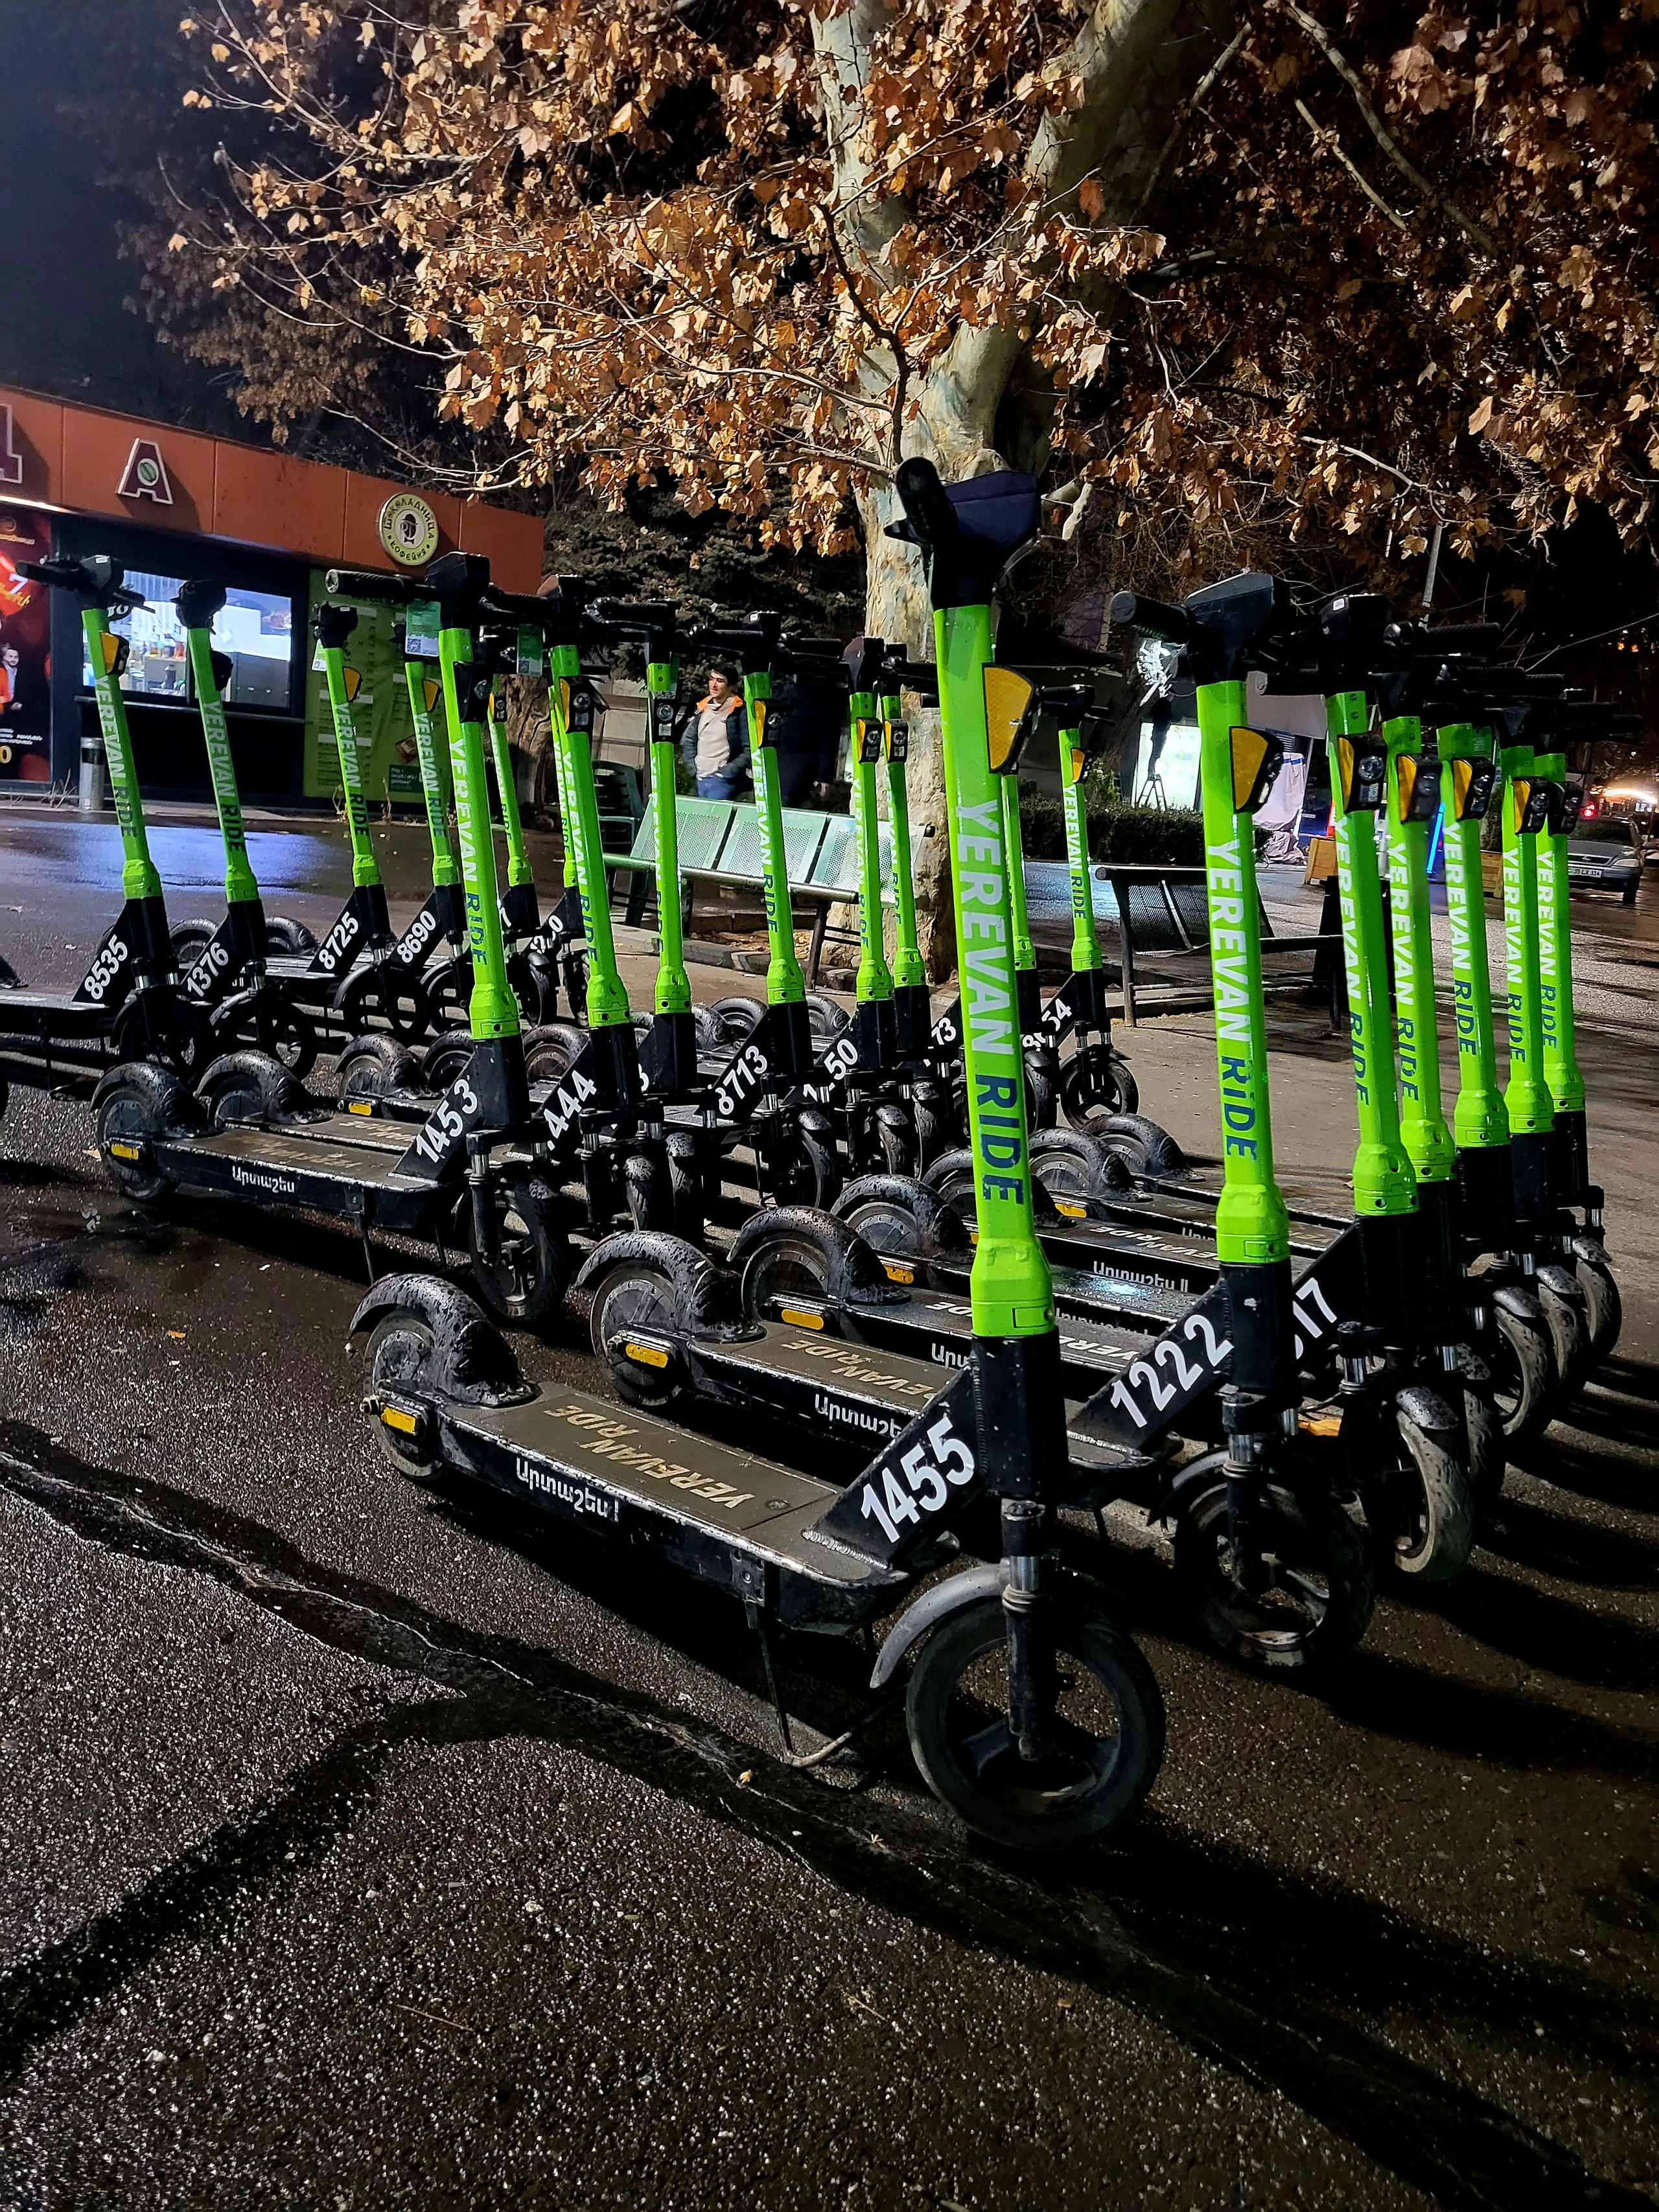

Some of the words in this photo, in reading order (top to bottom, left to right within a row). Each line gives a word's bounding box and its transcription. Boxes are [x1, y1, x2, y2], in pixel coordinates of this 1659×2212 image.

[390, 541, 426, 561] КОФЕЙНЯ
[96, 675, 126, 778] YEREVAN
[114, 786, 137, 837] RIDE
[203, 701, 235, 797] YEREVAN
[220, 803, 244, 852] RIDE
[335, 703, 361, 787] YEREVAN
[349, 793, 369, 836] RIDE
[415, 712, 439, 792] YEREVAN
[449, 738, 478, 882] YEREVAN
[466, 892, 487, 966] RIDE
[563, 751, 587, 885] YEREVAN
[580, 895, 597, 962] RIDE
[751, 749, 772, 865] YEREVAN
[763, 873, 778, 933] RIDE
[1063, 784, 1082, 870] YEREVAN
[956, 799, 1014, 1055] YEREVAN
[1071, 876, 1086, 919] RIDE
[1389, 843, 1414, 1006] YEREVAN
[1443, 822, 1472, 970] YEREVAN
[1503, 848, 1522, 983] YEREVAN
[1537, 850, 1555, 975] YEREVAN
[85, 934, 128, 999] 8535
[187, 942, 229, 997] 1376
[319, 911, 358, 970] 8725
[397, 911, 436, 963] 8690
[1207, 839, 1251, 1043] YEREVAN
[1334, 816, 1362, 999] YEREVAN
[1350, 1012, 1370, 1106] RIDE
[1454, 979, 1477, 1056] RIDE
[1507, 993, 1526, 1063] RIDE
[1541, 985, 1557, 1049] RIDE
[715, 1045, 767, 1115] 8713
[1397, 1017, 1419, 1101] RIDE
[416, 1078, 478, 1163] 1453
[544, 1070, 597, 1151] 444
[975, 1073, 1024, 1205] RIDE
[1221, 1055, 1257, 1161] RIDE
[232, 1165, 295, 1193] Արտաշես
[1089, 1226, 1163, 1241] RIDE
[1137, 1241, 1220, 1261] EVAN
[782, 1340, 870, 1365] RIDE
[831, 1365, 937, 1408] EVAN
[1110, 1314, 1235, 1428] 1222
[543, 1405, 639, 1438] RIDE
[815, 1393, 902, 1438] Արտաշե
[516, 1457, 607, 1517] Արտաշես
[579, 1439, 755, 1508] YEREVAN
[861, 1417, 975, 1543] 1455
